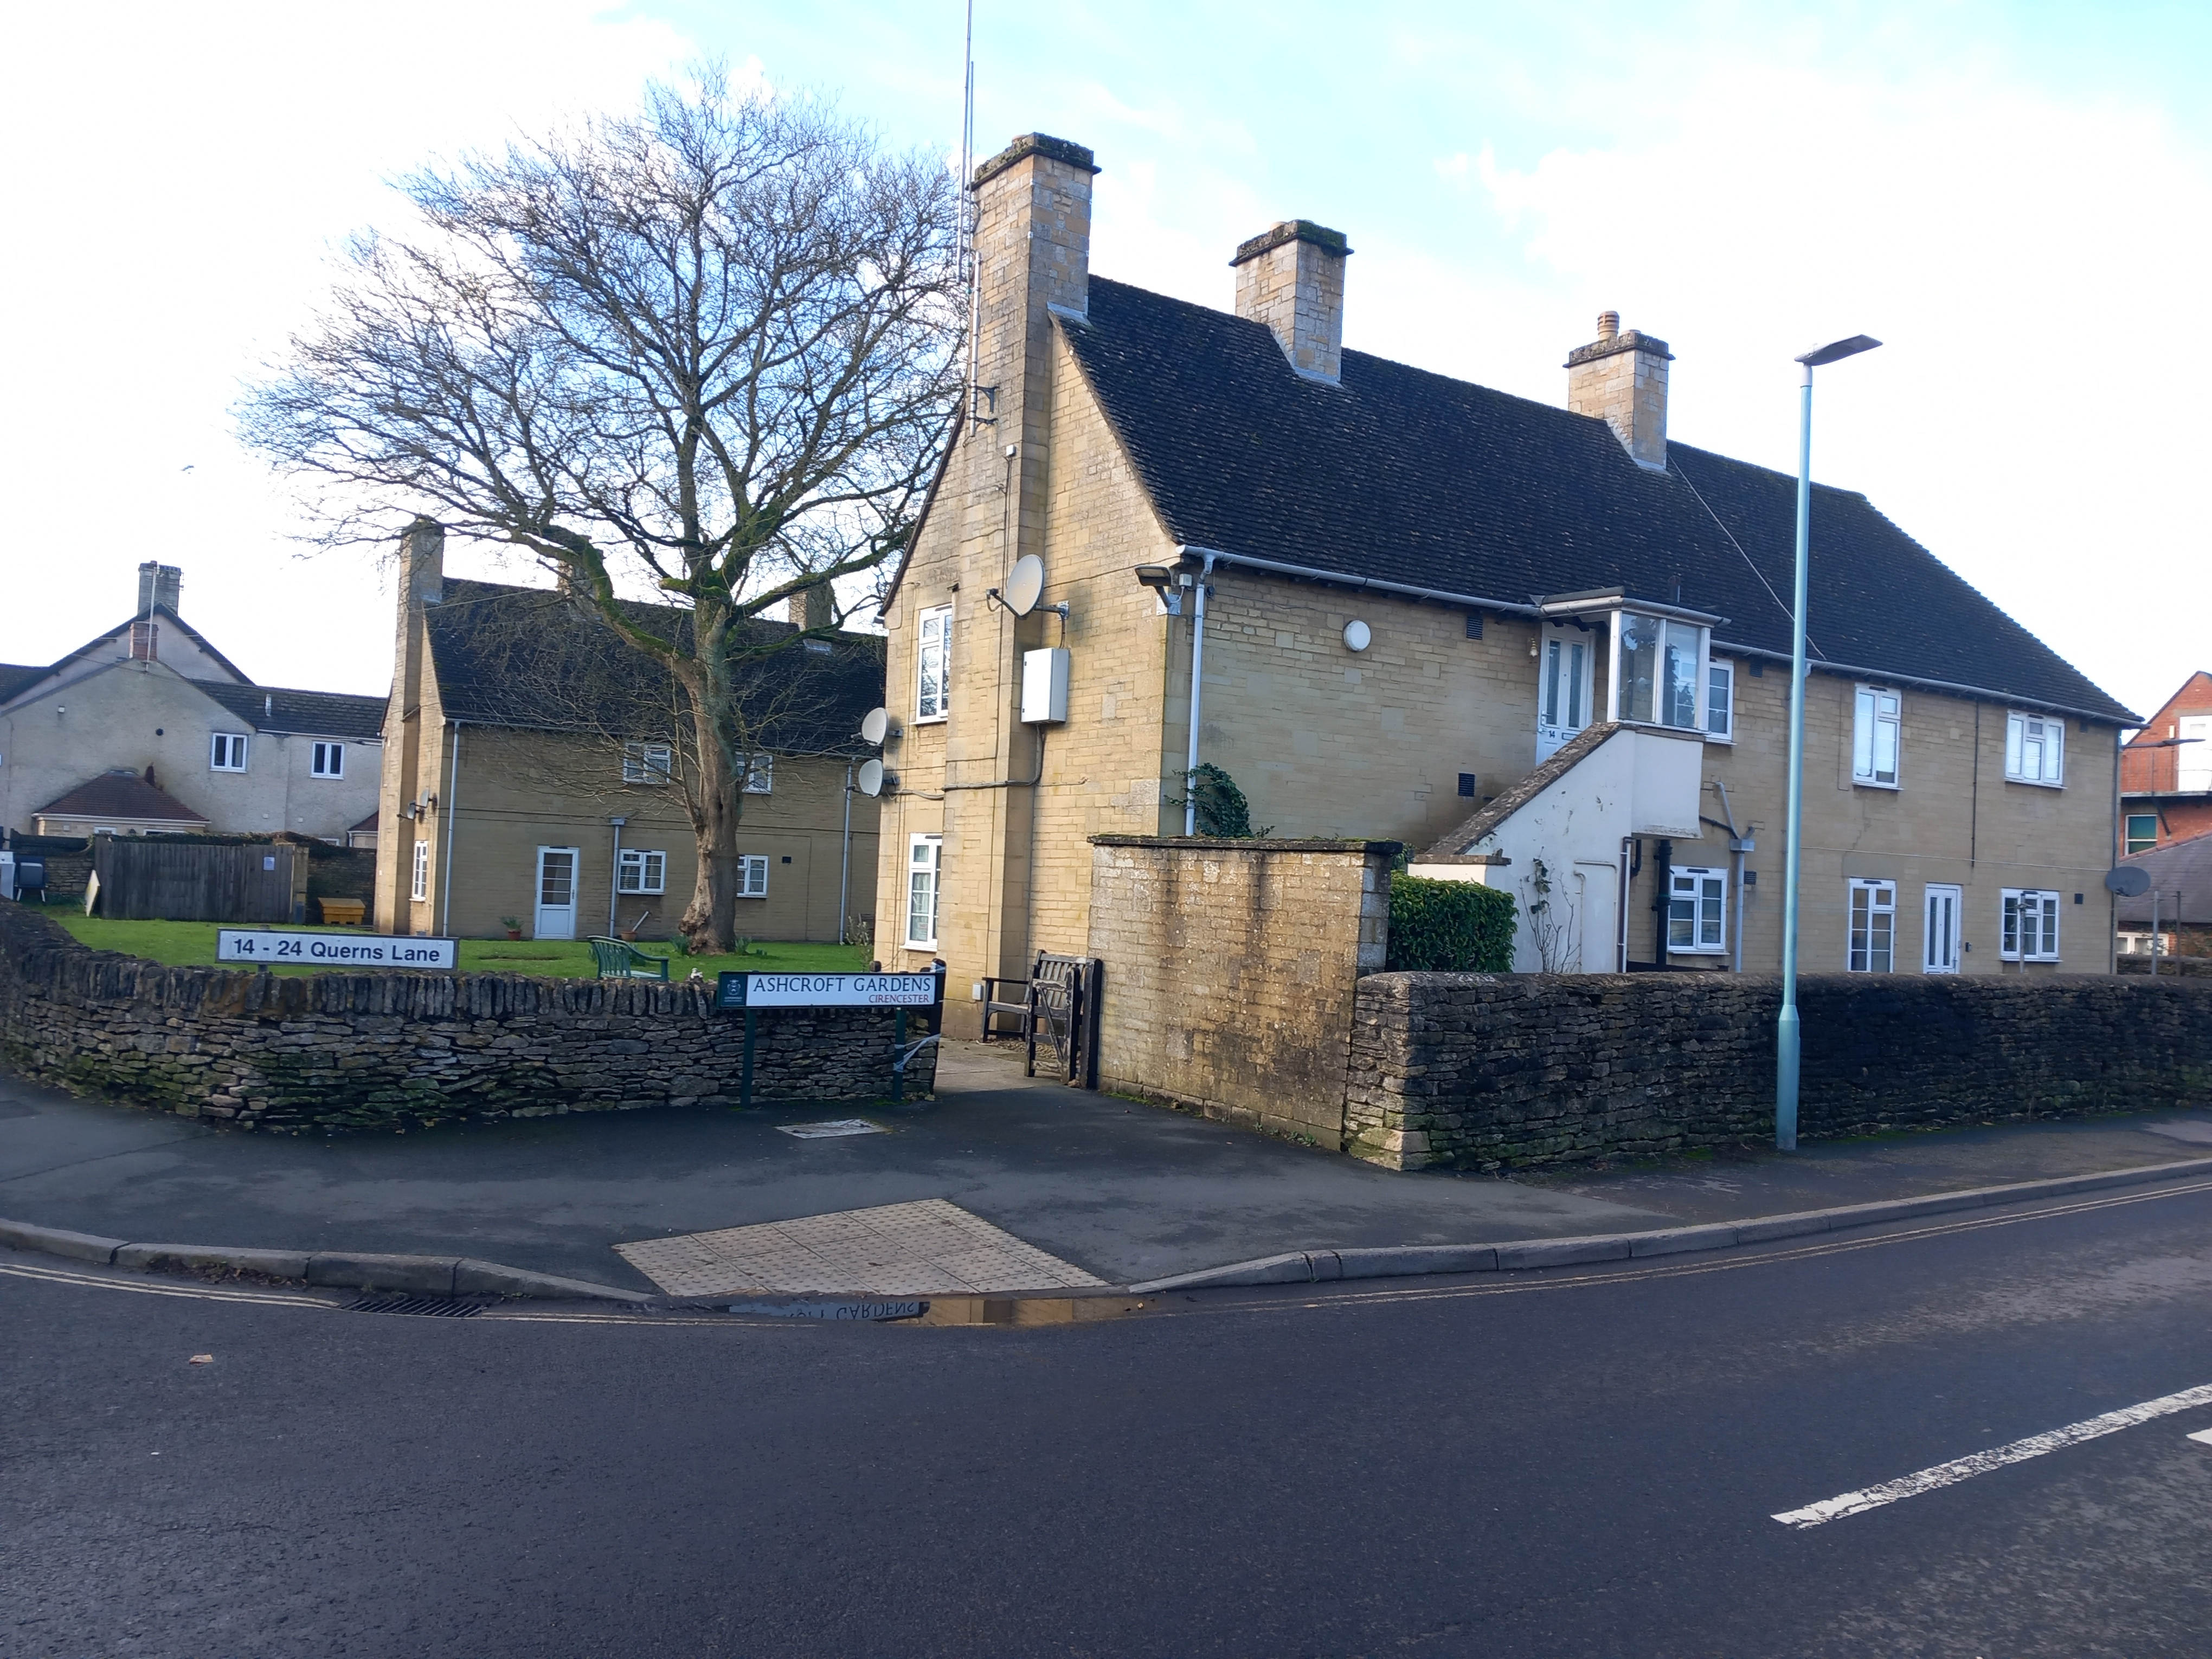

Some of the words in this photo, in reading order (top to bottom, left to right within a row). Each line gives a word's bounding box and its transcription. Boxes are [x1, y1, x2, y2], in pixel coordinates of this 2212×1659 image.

[234, 939, 255, 954] 14
[277, 940, 303, 956] 24
[311, 942, 383, 960] Querns
[392, 945, 440, 962] Lane
[753, 977, 846, 992] ASHCROFT
[853, 977, 931, 992] GARDENS
[869, 994, 930, 1004] CIRENCESTER
